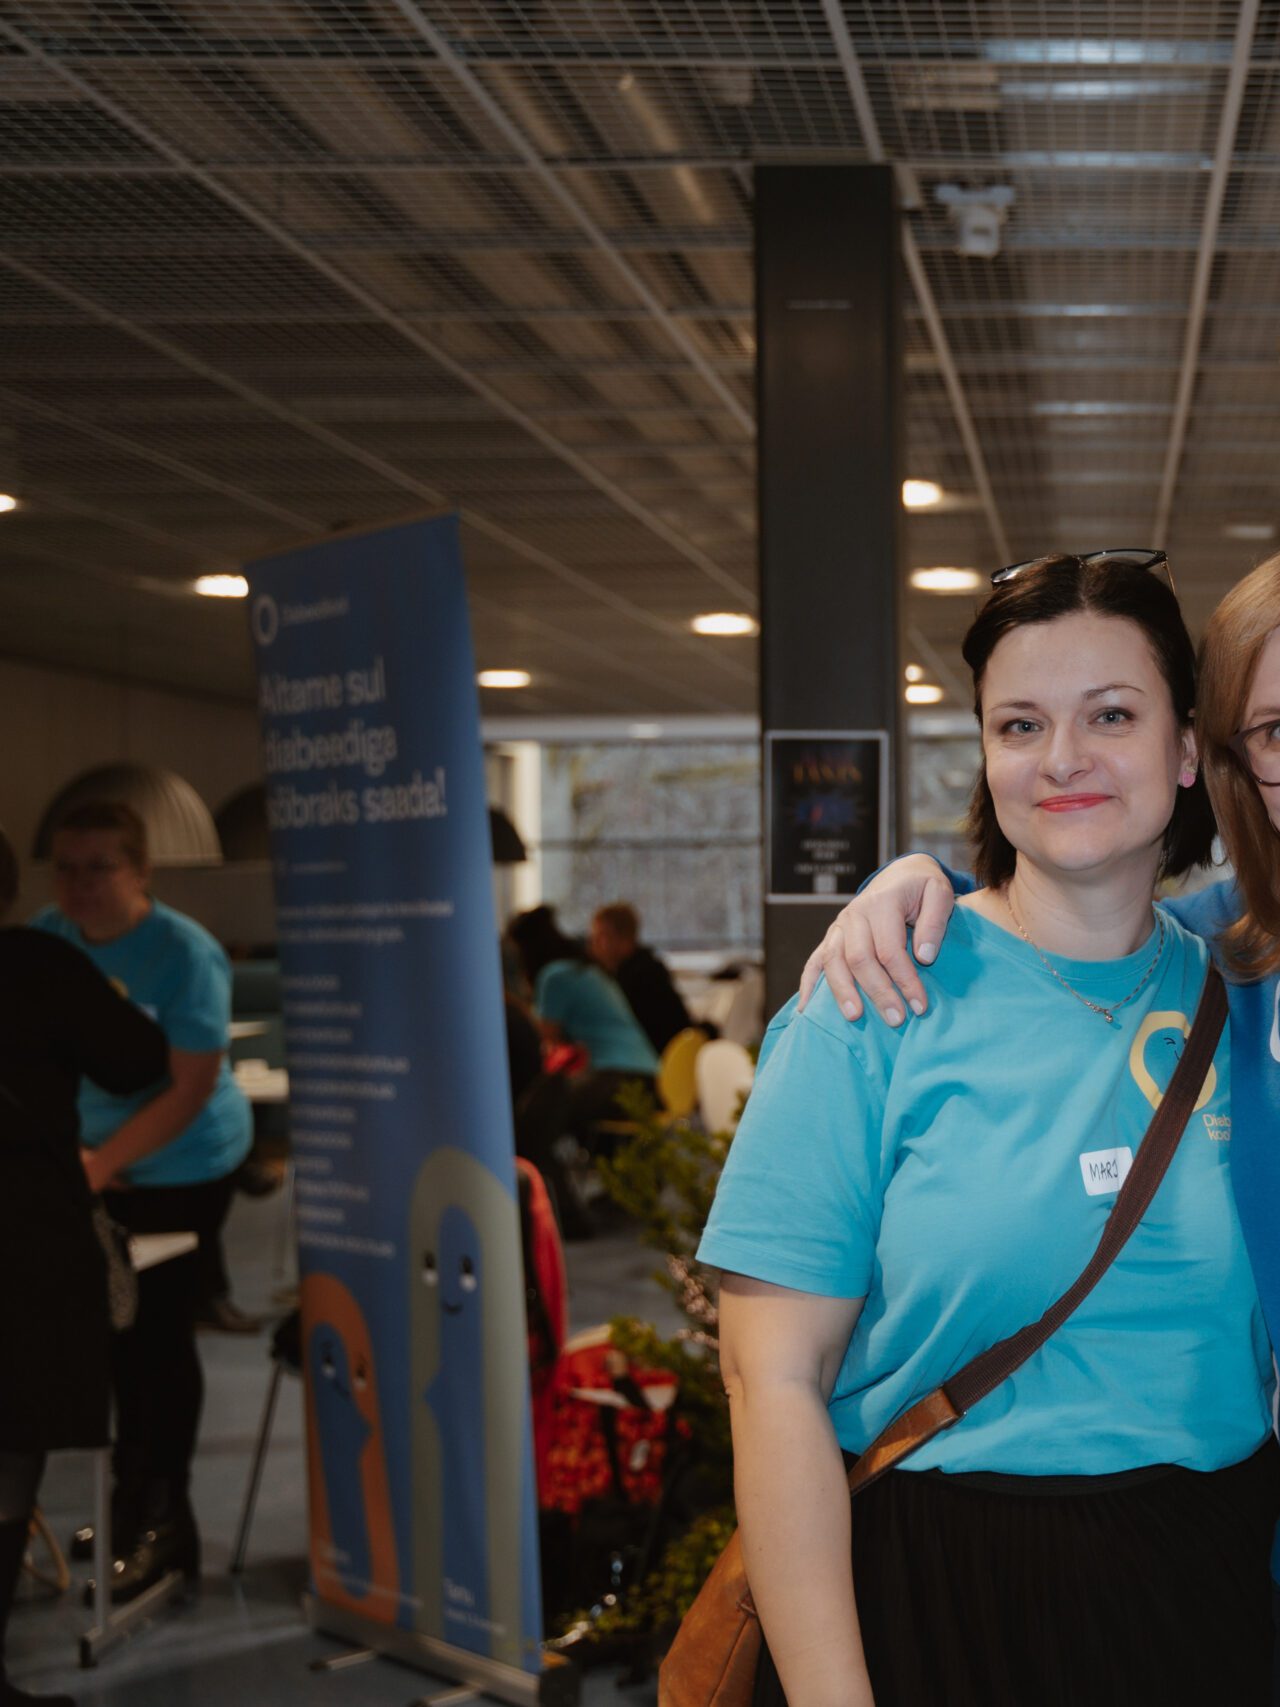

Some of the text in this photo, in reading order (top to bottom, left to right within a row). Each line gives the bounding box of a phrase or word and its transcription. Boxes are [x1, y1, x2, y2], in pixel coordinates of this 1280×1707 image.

[345, 655, 387, 704] sul
[266, 719, 397, 777] diabeediga
[362, 766, 449, 823] saada!
